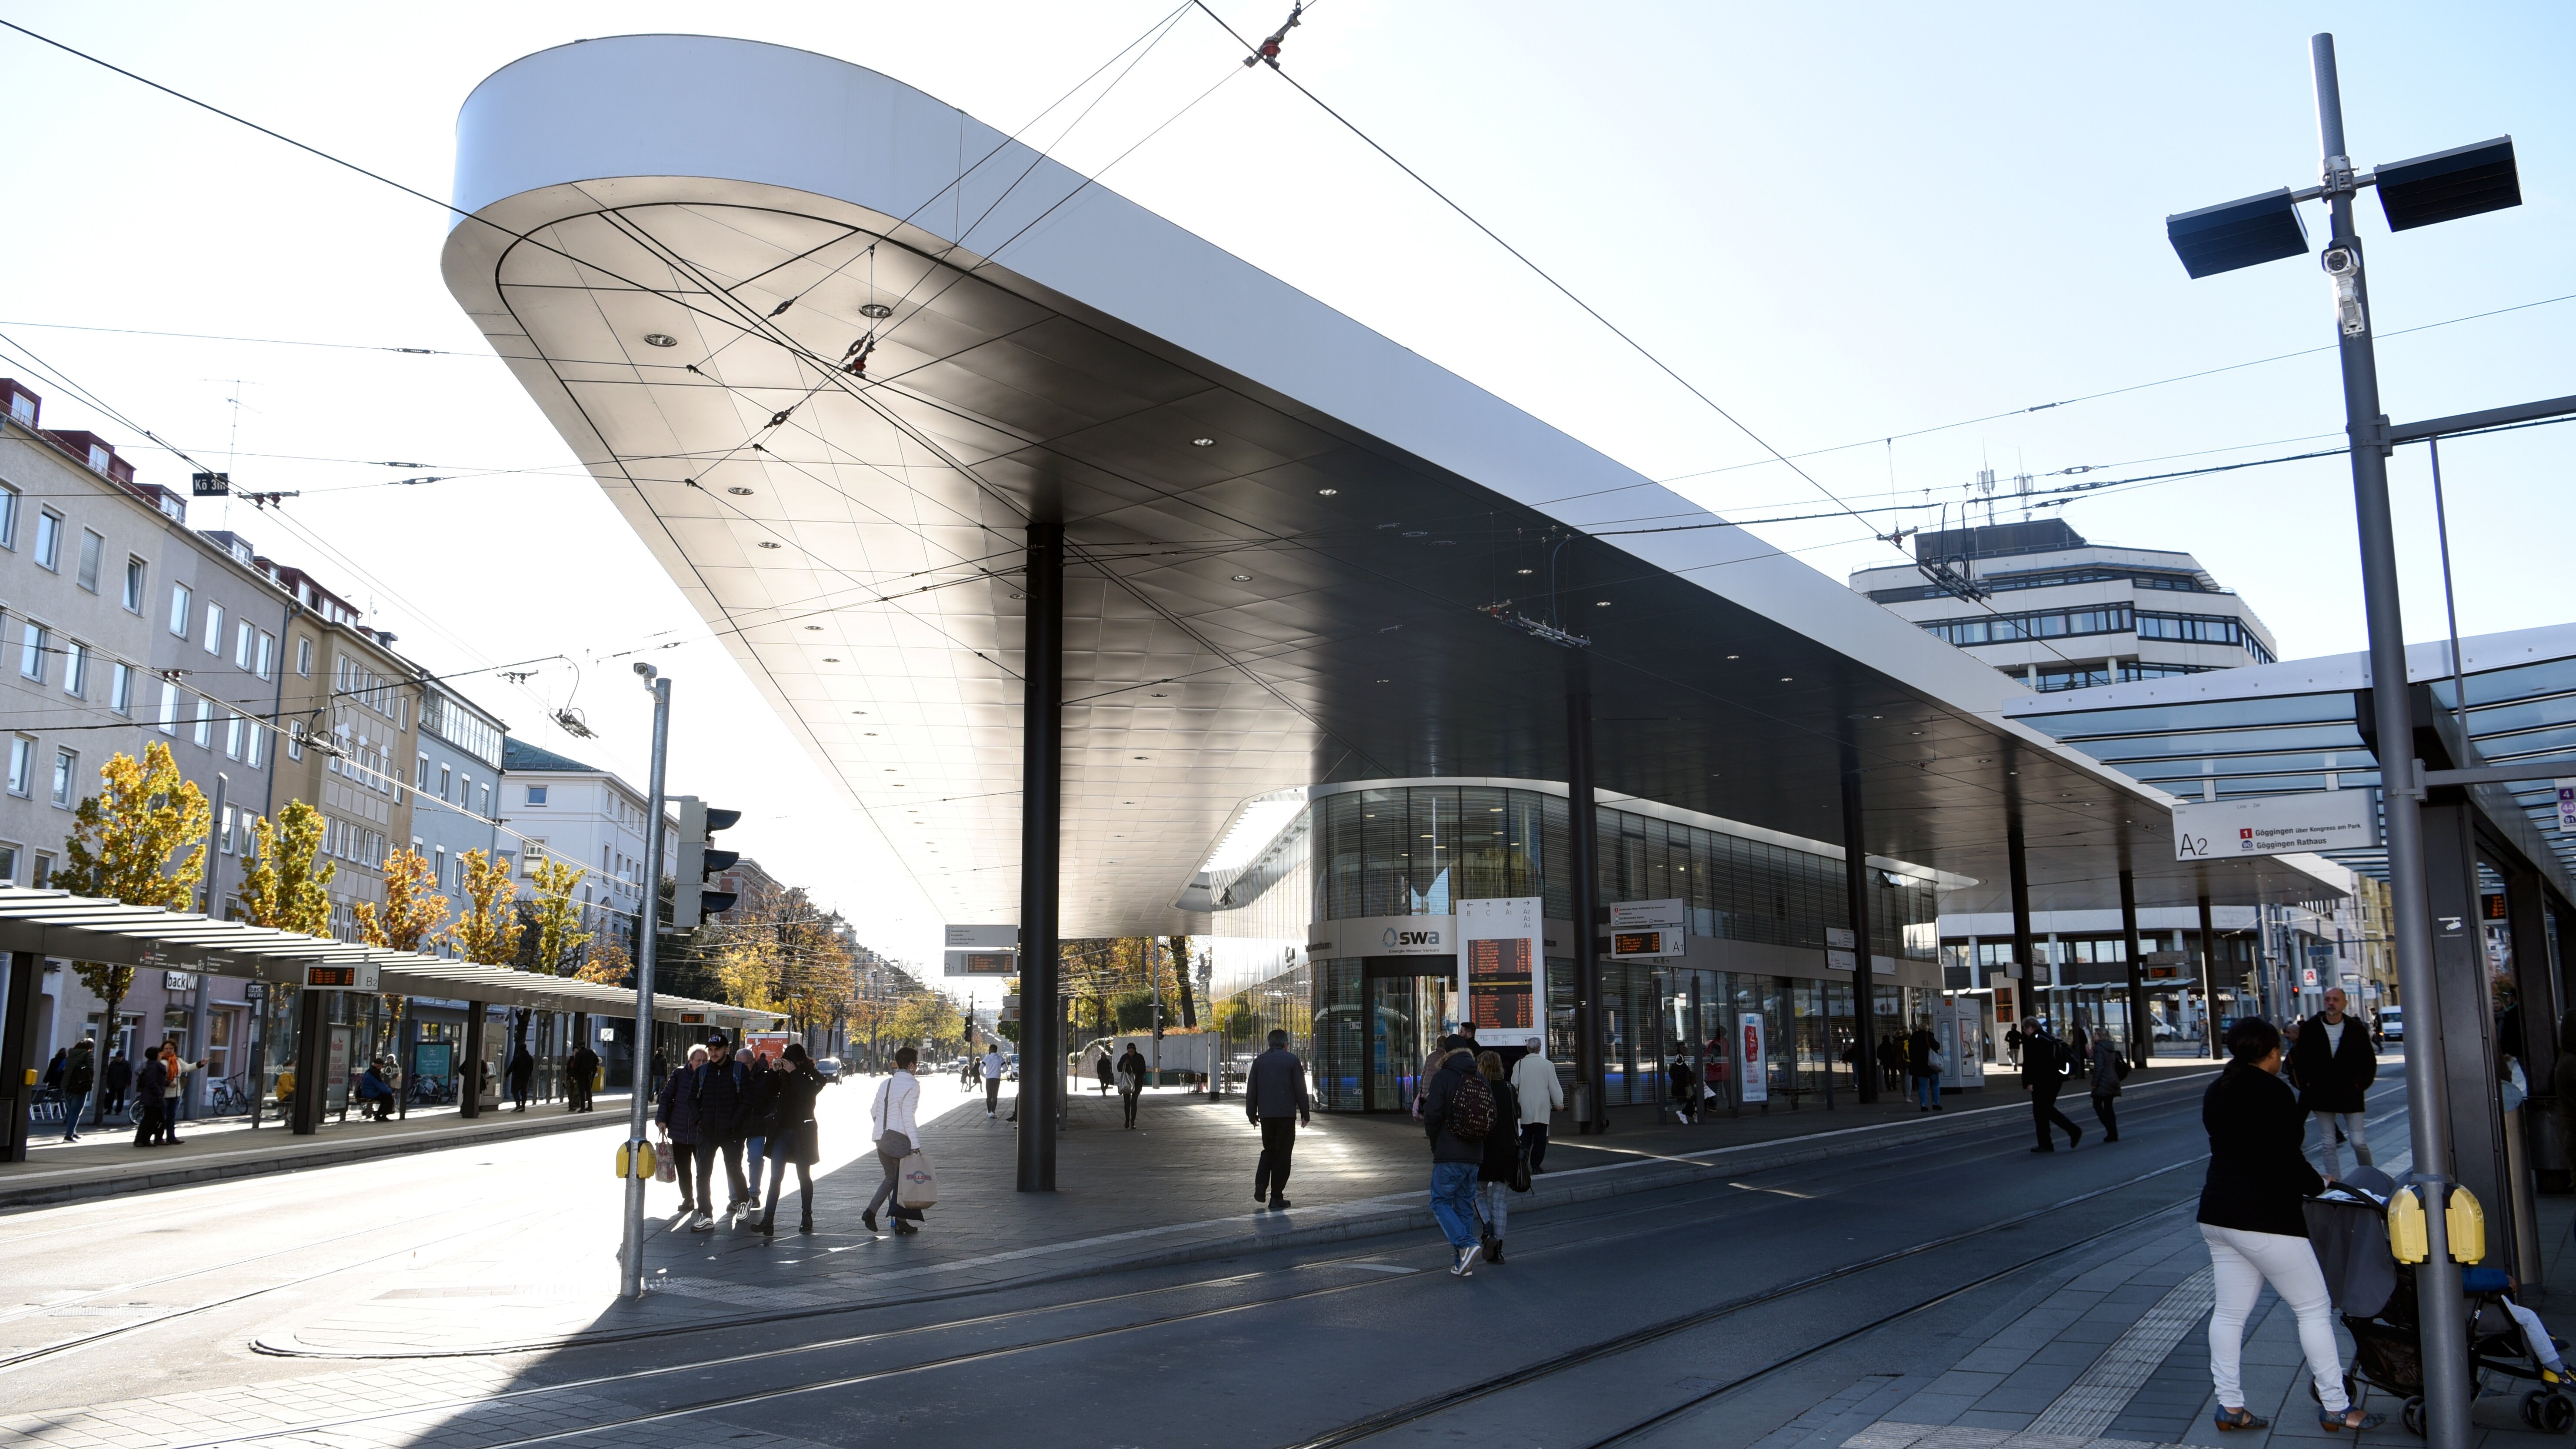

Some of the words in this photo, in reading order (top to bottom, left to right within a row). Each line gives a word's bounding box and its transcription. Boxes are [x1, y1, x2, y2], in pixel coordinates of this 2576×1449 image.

[195, 479, 207, 490] Kö
[211, 479, 226, 490] 3m
[2255, 828, 2293, 837] Göggingen
[2179, 833, 2209, 857] A2
[2256, 840, 2295, 850] Göggingen
[2297, 838, 2327, 846] Rathaus
[1400, 931, 1440, 945] swa
[1673, 941, 1683, 952] A1
[198, 959, 204, 971] B2
[944, 963, 955, 973] B1
[366, 976, 377, 986] B2
